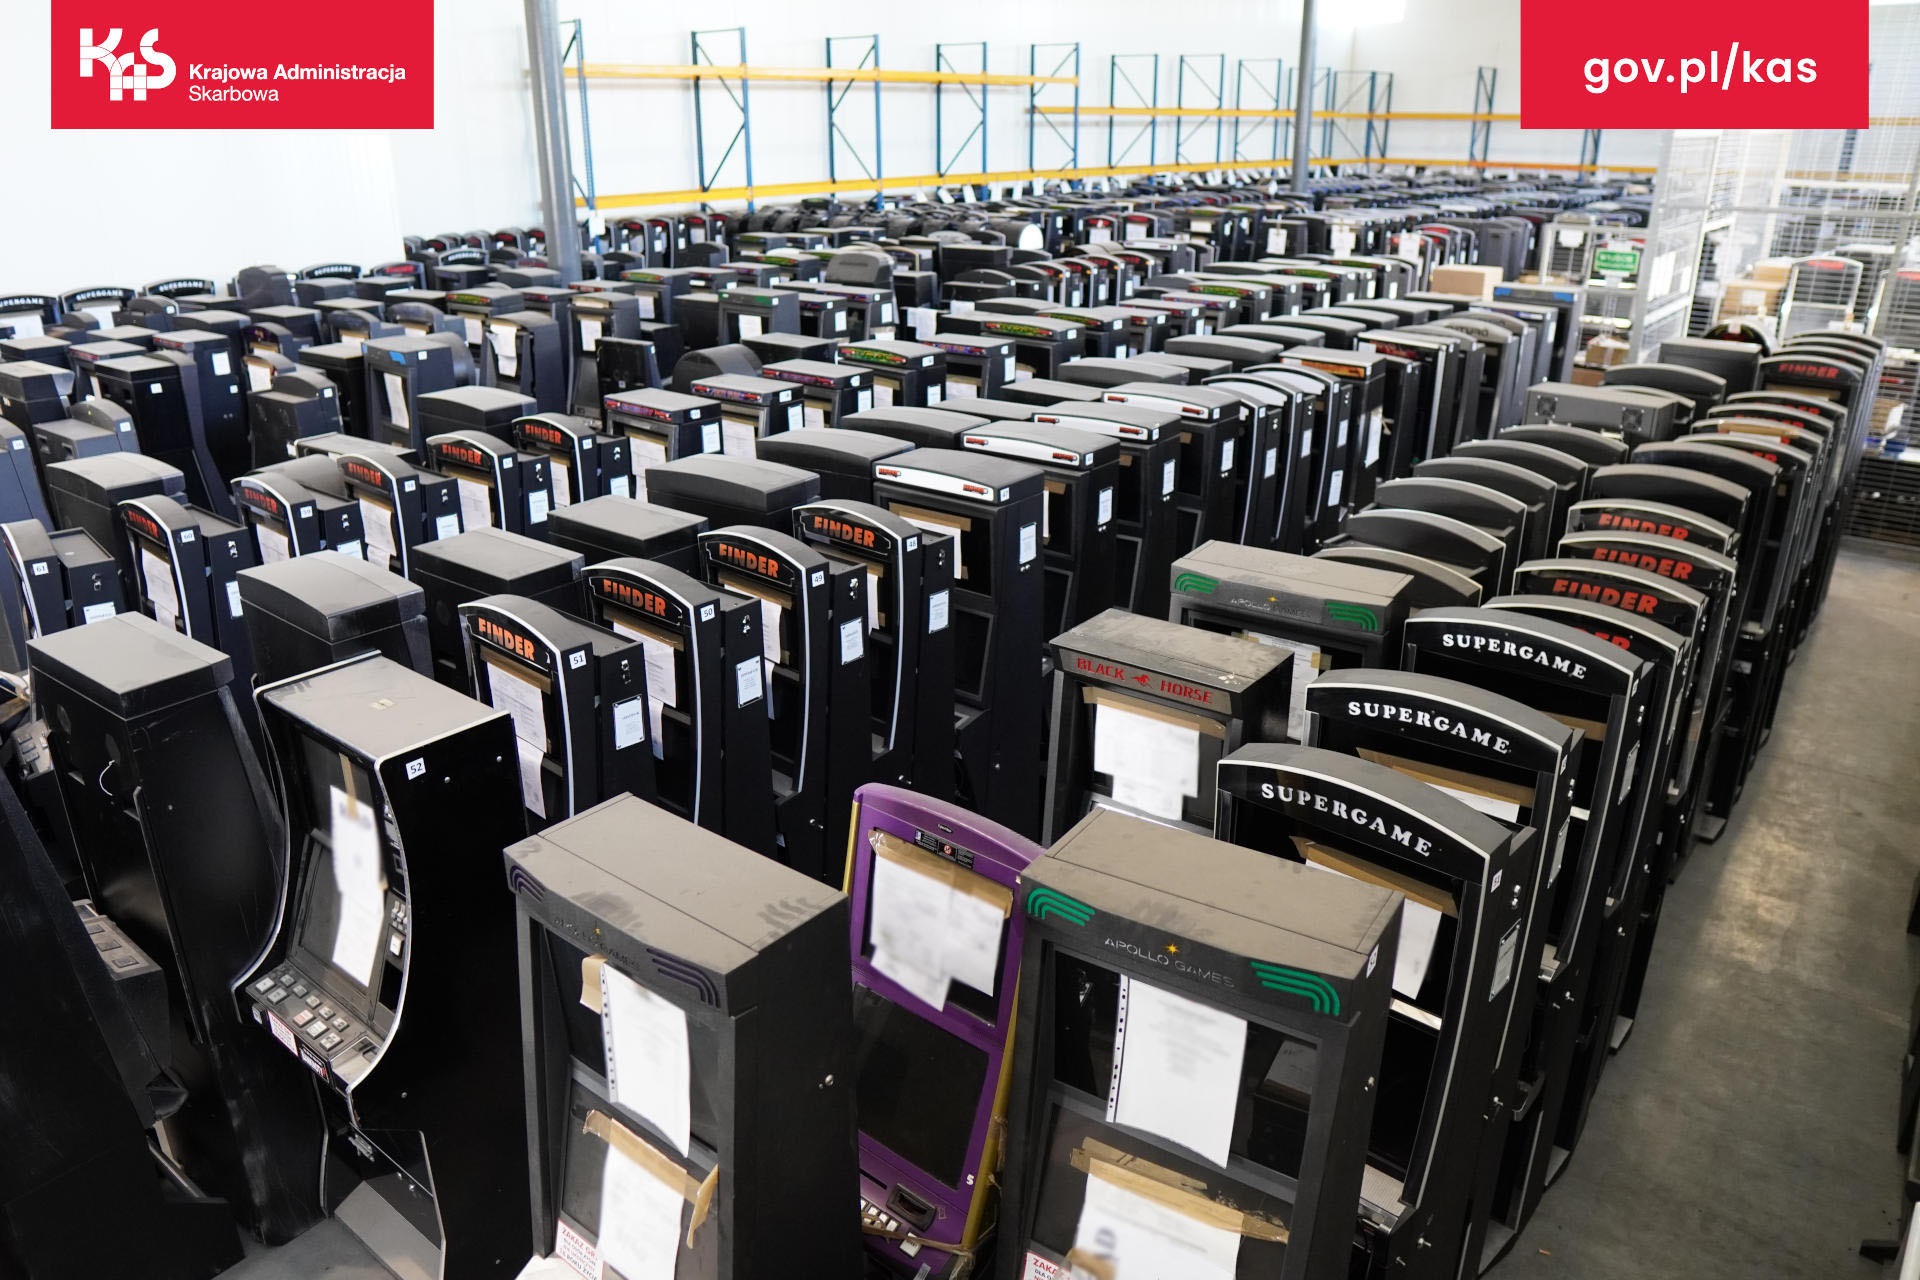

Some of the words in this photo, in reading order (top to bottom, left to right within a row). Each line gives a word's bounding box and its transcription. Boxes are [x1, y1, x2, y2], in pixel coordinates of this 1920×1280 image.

[1779, 363, 1840, 379] FINDER
[525, 423, 562, 445] FINDER
[442, 443, 482, 466] FINDER
[348, 461, 382, 488] FINDER
[244, 488, 278, 514] FINDER
[128, 510, 159, 538] FINDER
[814, 515, 876, 547] FINDER
[1598, 513, 1689, 541] FINDER
[719, 543, 779, 579] FINDER
[1594, 548, 1693, 580] FINDER
[814, 574, 823, 584] 49
[603, 578, 667, 617] FINDER
[1553, 579, 1659, 614] FINDER
[703, 606, 714, 618] 50
[478, 617, 536, 660] FINDER
[574, 656, 584, 665] 51
[1442, 633, 1587, 680] SUPERGAME
[1076, 657, 1125, 682] BLACK
[1159, 679, 1213, 705] HORSE
[1348, 701, 1510, 754] SUPERGAME
[409, 762, 424, 774] 52
[1261, 782, 1433, 858] SUPERGAME
[1104, 936, 1170, 966] APOLLO
[1175, 959, 1235, 989] GAMES
